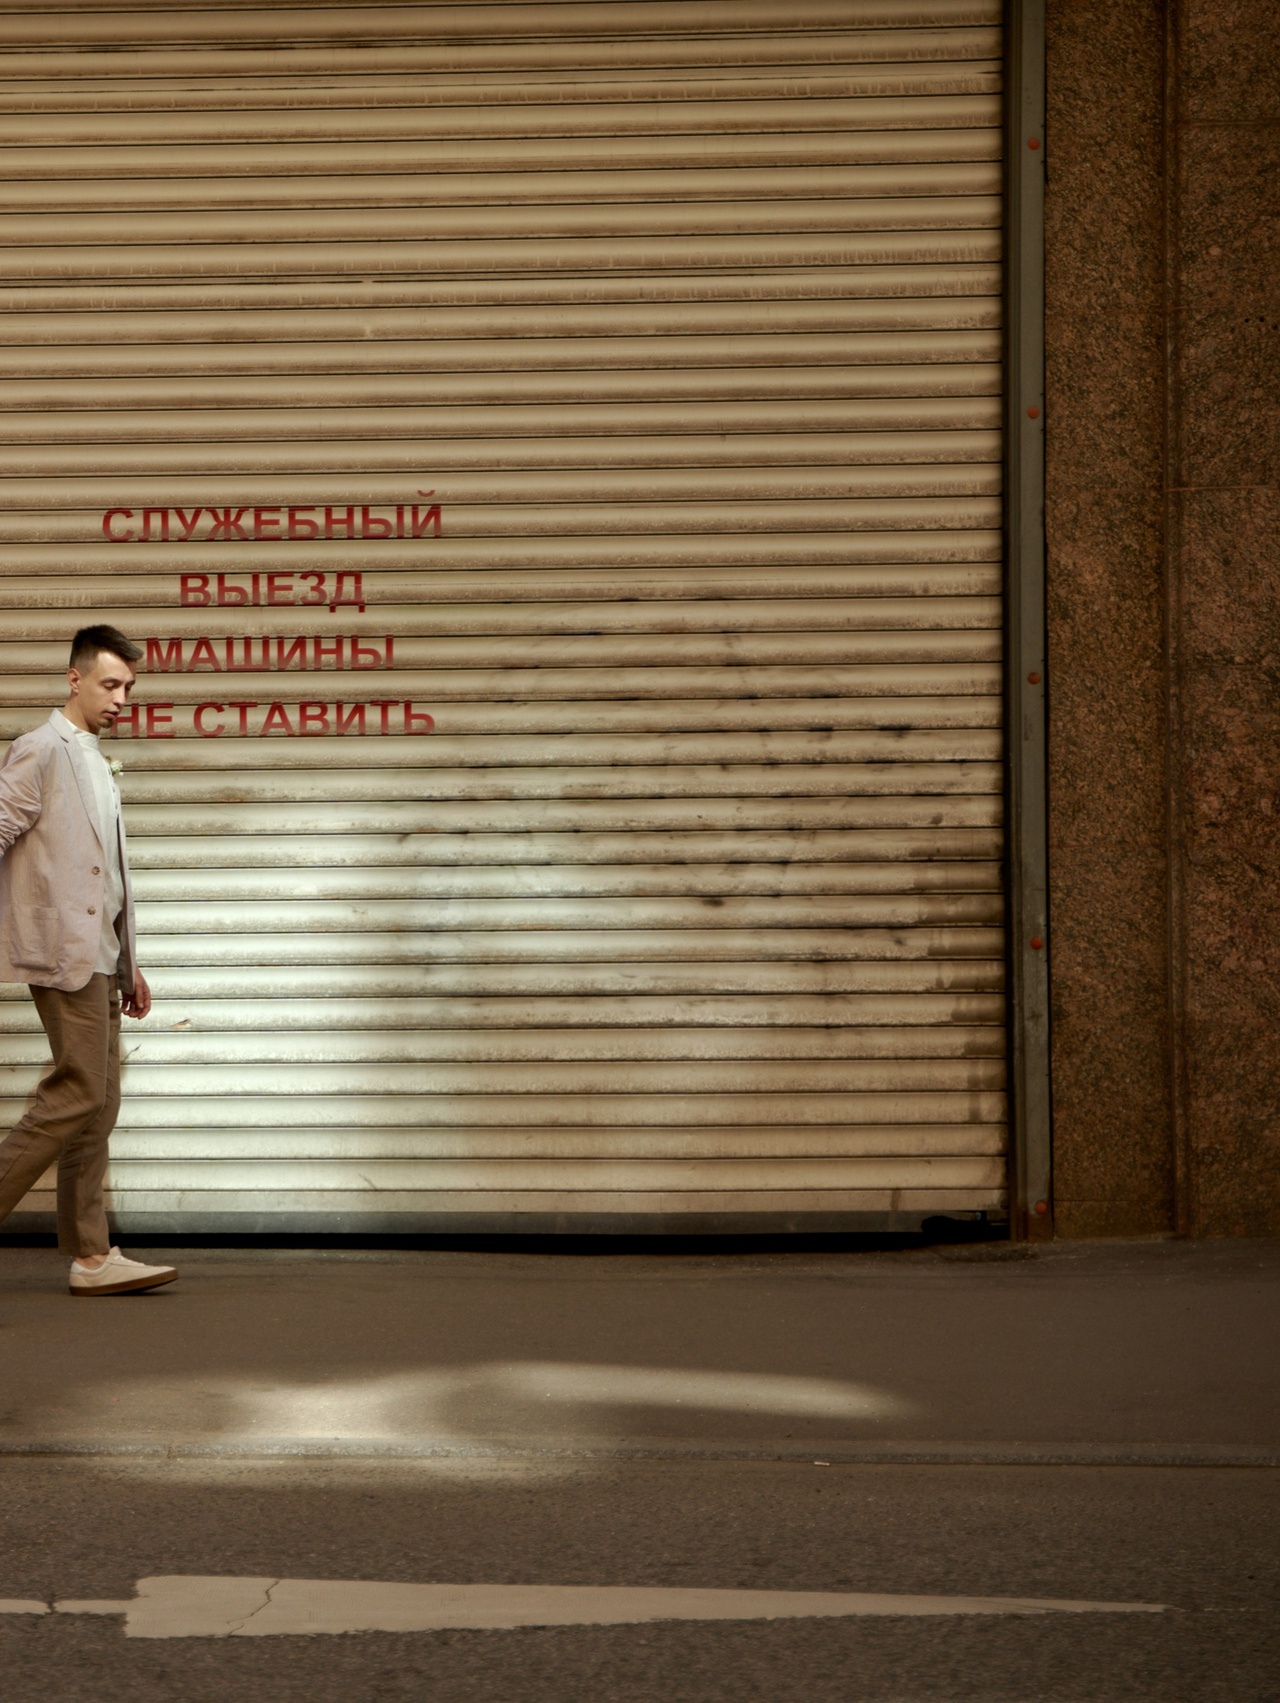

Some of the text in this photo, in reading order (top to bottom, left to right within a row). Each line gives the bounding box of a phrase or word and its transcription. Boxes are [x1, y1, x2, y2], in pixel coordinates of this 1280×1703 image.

[102, 490, 442, 541] СЛУЖЕБНЫЙ
[180, 571, 365, 613] ВЫЕЗД
[146, 634, 394, 672] МАШИНЫ
[109, 700, 435, 738] НЕ СТАВИТЬ
